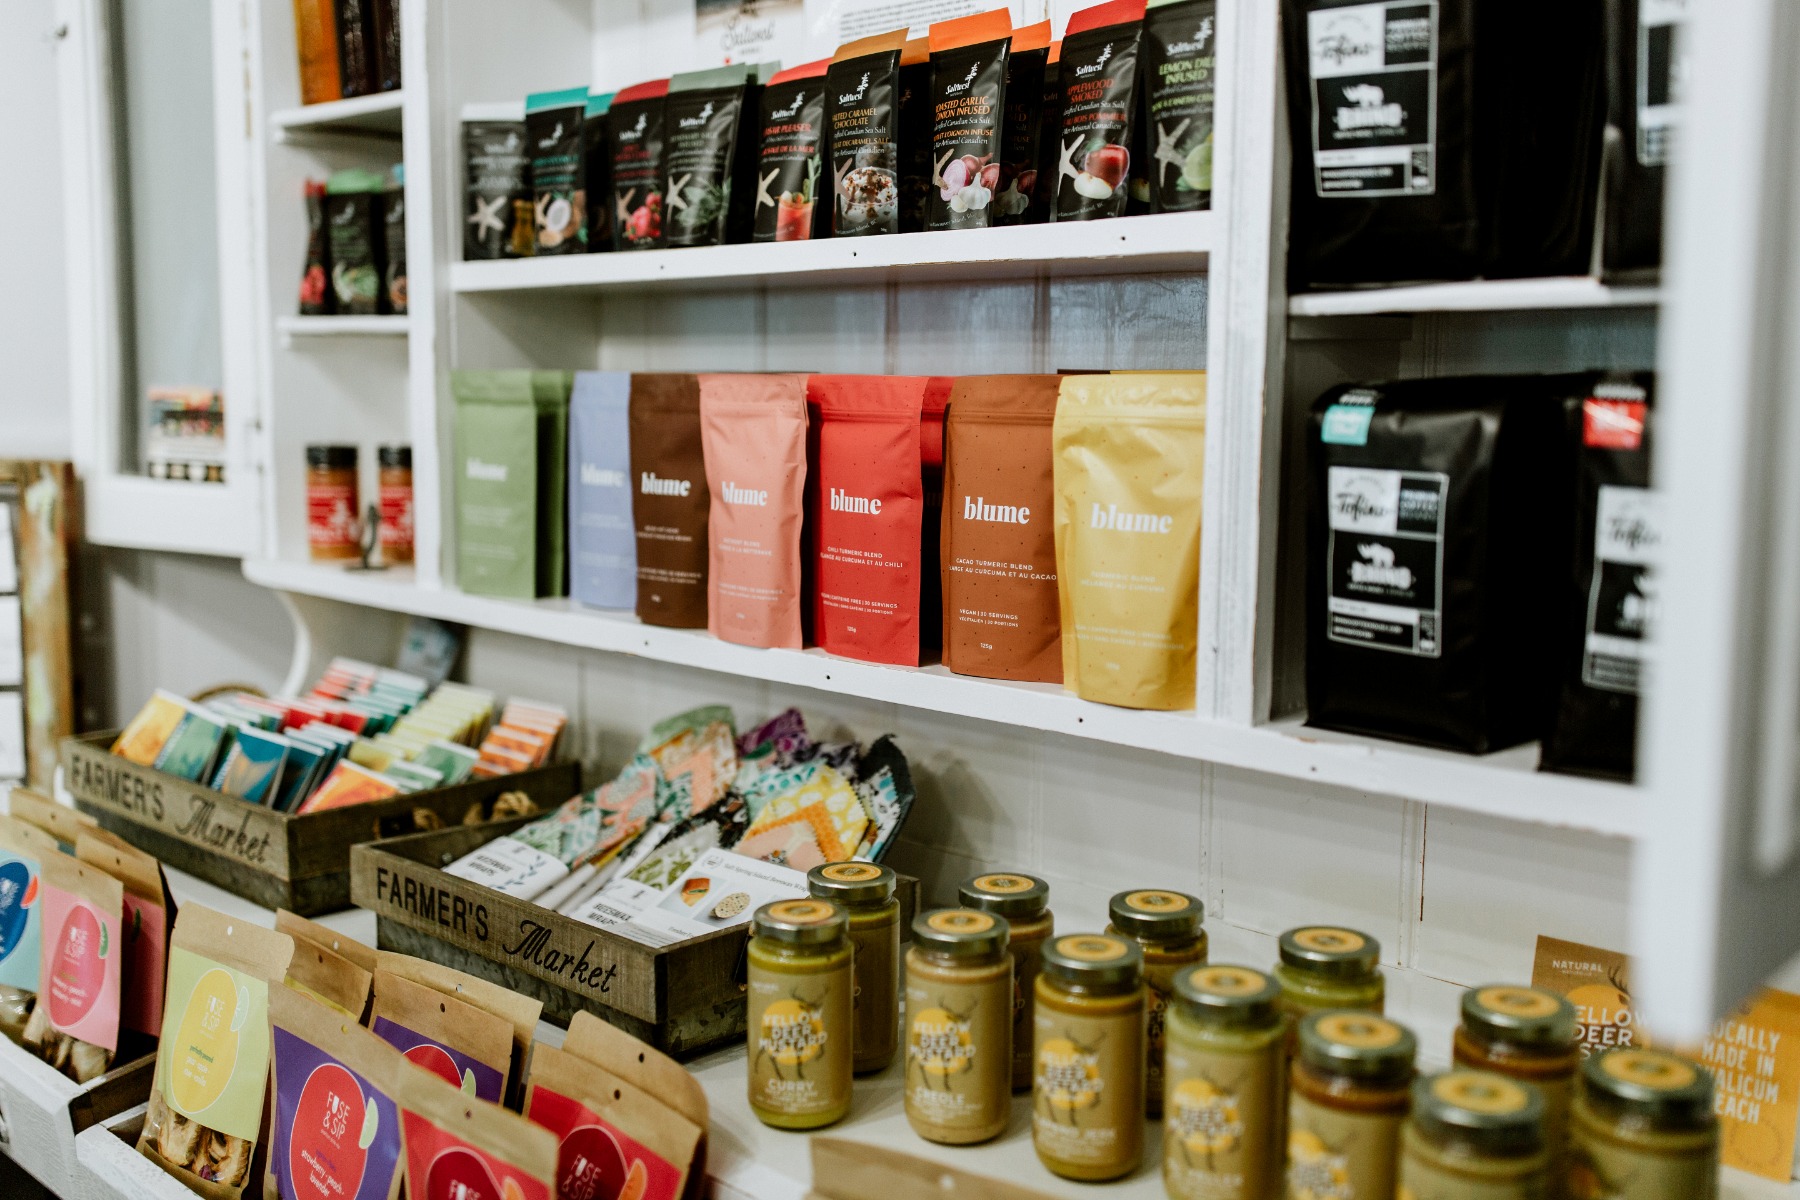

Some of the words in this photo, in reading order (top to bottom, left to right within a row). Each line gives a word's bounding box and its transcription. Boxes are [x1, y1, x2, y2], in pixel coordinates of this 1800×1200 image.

[1159, 58, 1192, 76] LEMON
[1165, 69, 1208, 85] INFUSED
[1067, 78, 1114, 97] APPLEWOOD
[960, 96, 989, 107] GARLIC
[1071, 90, 1103, 104] SMOKED
[848, 107, 877, 119] CARAMEL
[935, 108, 955, 121] ONION
[956, 105, 991, 116] INFUSED
[979, 116, 990, 124] Salt
[834, 118, 868, 129] CHOCOLATE
[874, 125, 886, 134] Salt
[641, 471, 691, 497] blume
[721, 481, 768, 507] blume
[830, 487, 882, 515] blume
[964, 495, 1030, 525] blume
[1090, 502, 1173, 534] blume
[839, 548, 863, 557] TURMERIC
[863, 551, 883, 559] BLEND
[842, 556, 865, 565] CURCUMA
[956, 557, 974, 565] CACAO
[976, 560, 1008, 569] TURMERIC
[1010, 563, 1033, 571] BLEND
[975, 568, 1007, 577] CURCUMA
[871, 601, 898, 609] SERVINGS
[959, 608, 976, 616] VEGAN
[988, 612, 1019, 620] SERVINGS
[980, 642, 993, 650] 125g
[71, 753, 165, 822] FARMER'S
[175, 793, 271, 864] Market
[376, 866, 489, 942] FARMER'S
[502, 919, 617, 994] Market
[1552, 960, 1604, 973] NATURAL
[762, 1009, 823, 1026] YELLOW
[771, 1023, 812, 1039] DEER
[1570, 1024, 1633, 1047] DEER
[758, 1031, 829, 1052] MUSTARD
[1701, 1040, 1749, 1071] MADE
[1756, 1053, 1776, 1078] IN
[768, 1078, 815, 1092] CURRY
[1713, 1094, 1761, 1125] EACH
[322, 1110, 331, 1130] &
[330, 1117, 346, 1140] SIP
[301, 1149, 327, 1179] strawberry
[310, 1170, 330, 1197] lavender
